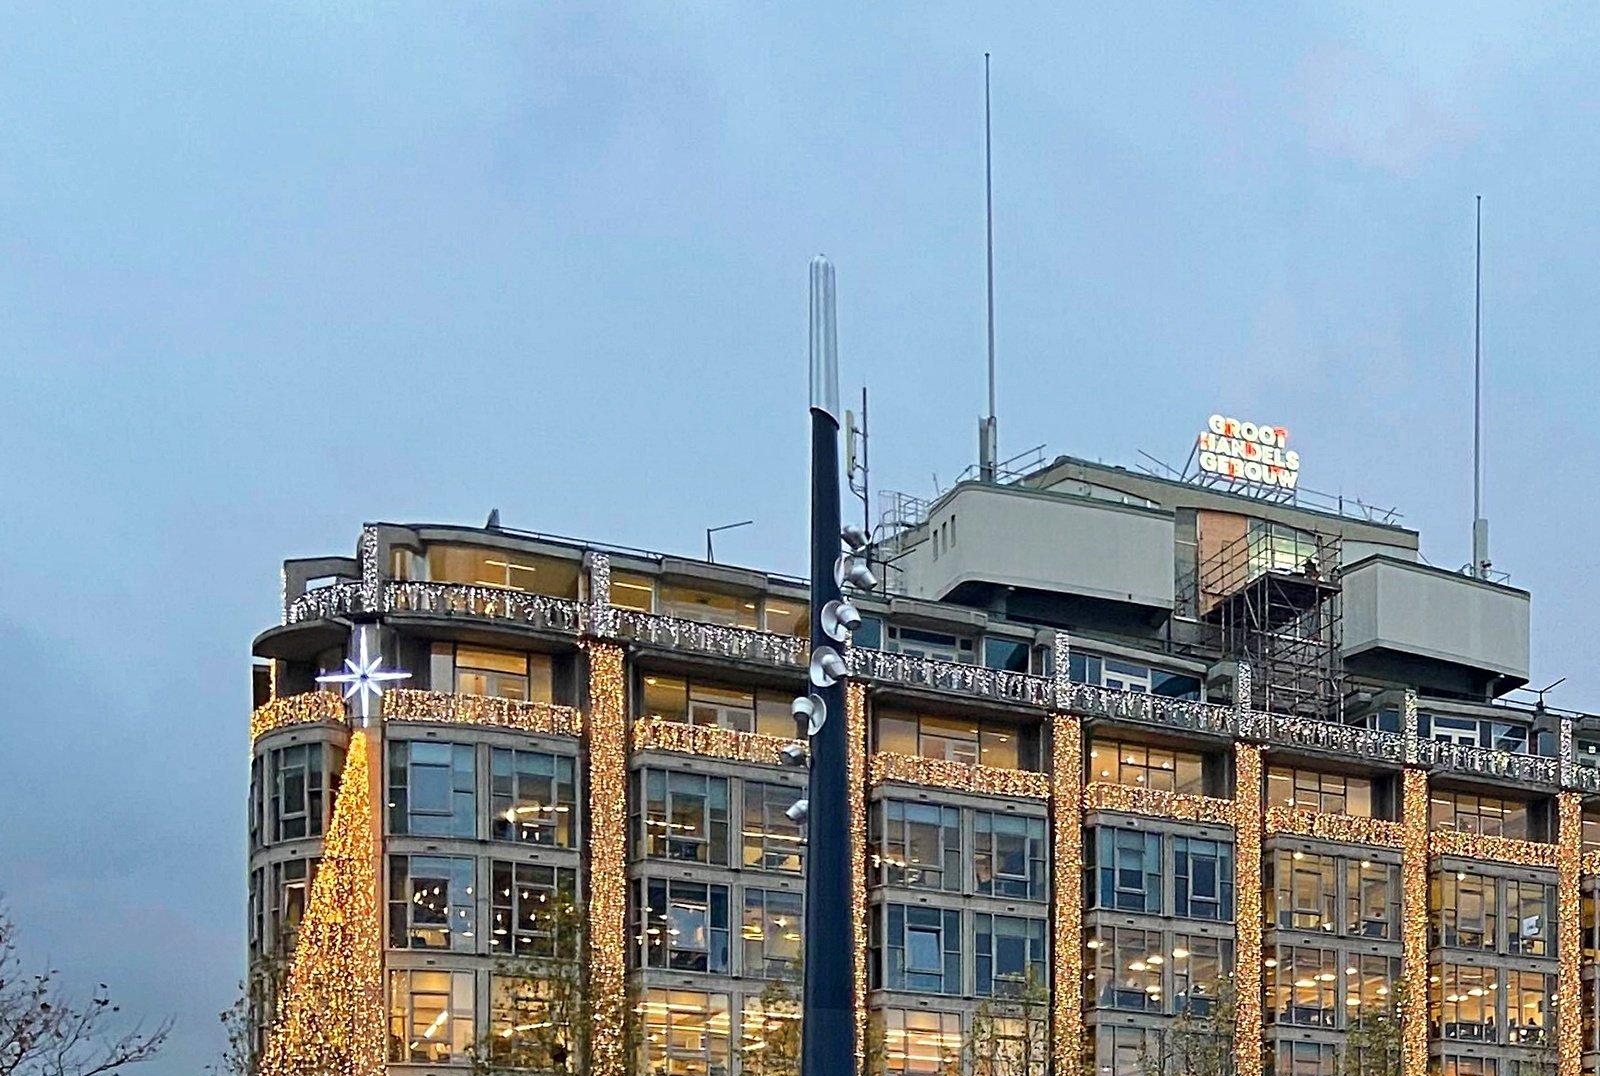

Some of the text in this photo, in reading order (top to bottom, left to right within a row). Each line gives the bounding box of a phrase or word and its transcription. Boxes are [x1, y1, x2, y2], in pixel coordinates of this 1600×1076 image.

[1209, 414, 1287, 448] GROOT
[1201, 431, 1299, 471] HANDELS
[1200, 452, 1298, 488] GEBOUW
